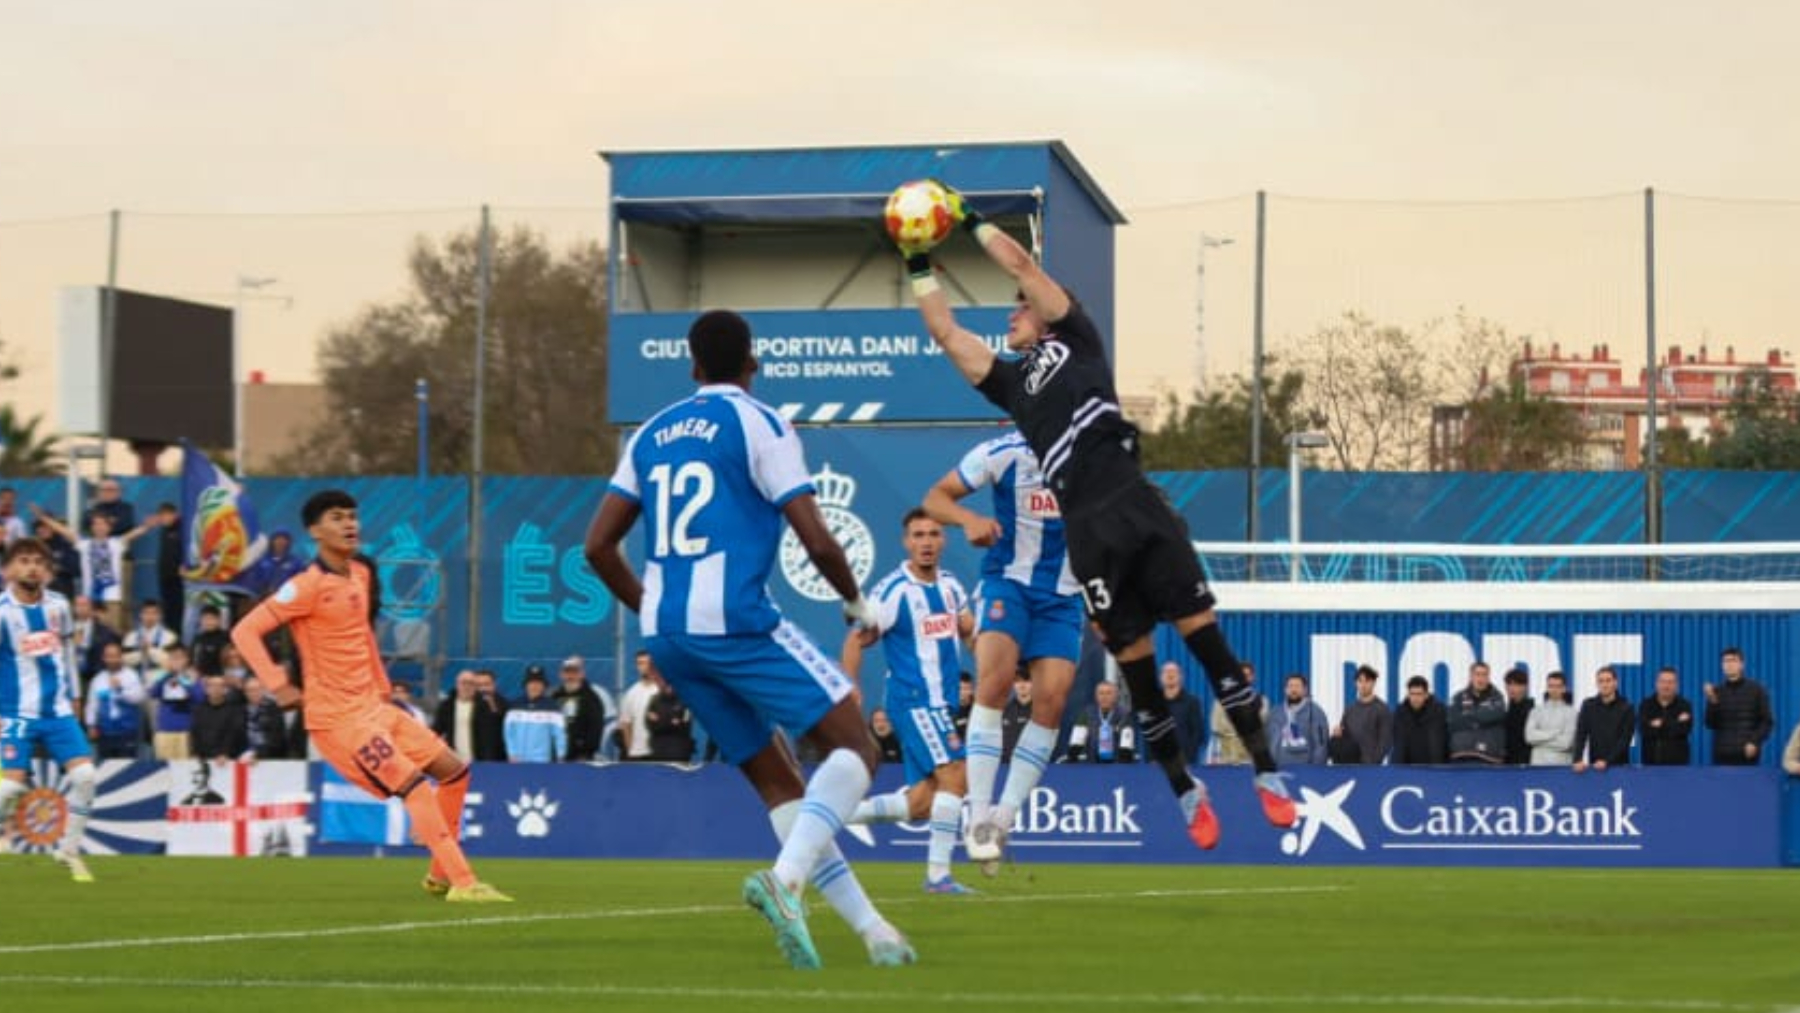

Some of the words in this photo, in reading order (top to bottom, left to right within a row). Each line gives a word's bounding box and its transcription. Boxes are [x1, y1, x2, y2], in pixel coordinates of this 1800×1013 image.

[640, 338, 692, 360] CIUT
[861, 335, 917, 356] DANI
[763, 362, 799, 378] RCD
[803, 360, 892, 378] ESPANYOL
[647, 460, 715, 558] 12
[1030, 494, 1056, 511] DA
[358, 734, 393, 771] 38
[1379, 784, 1642, 836] CaixaBank
